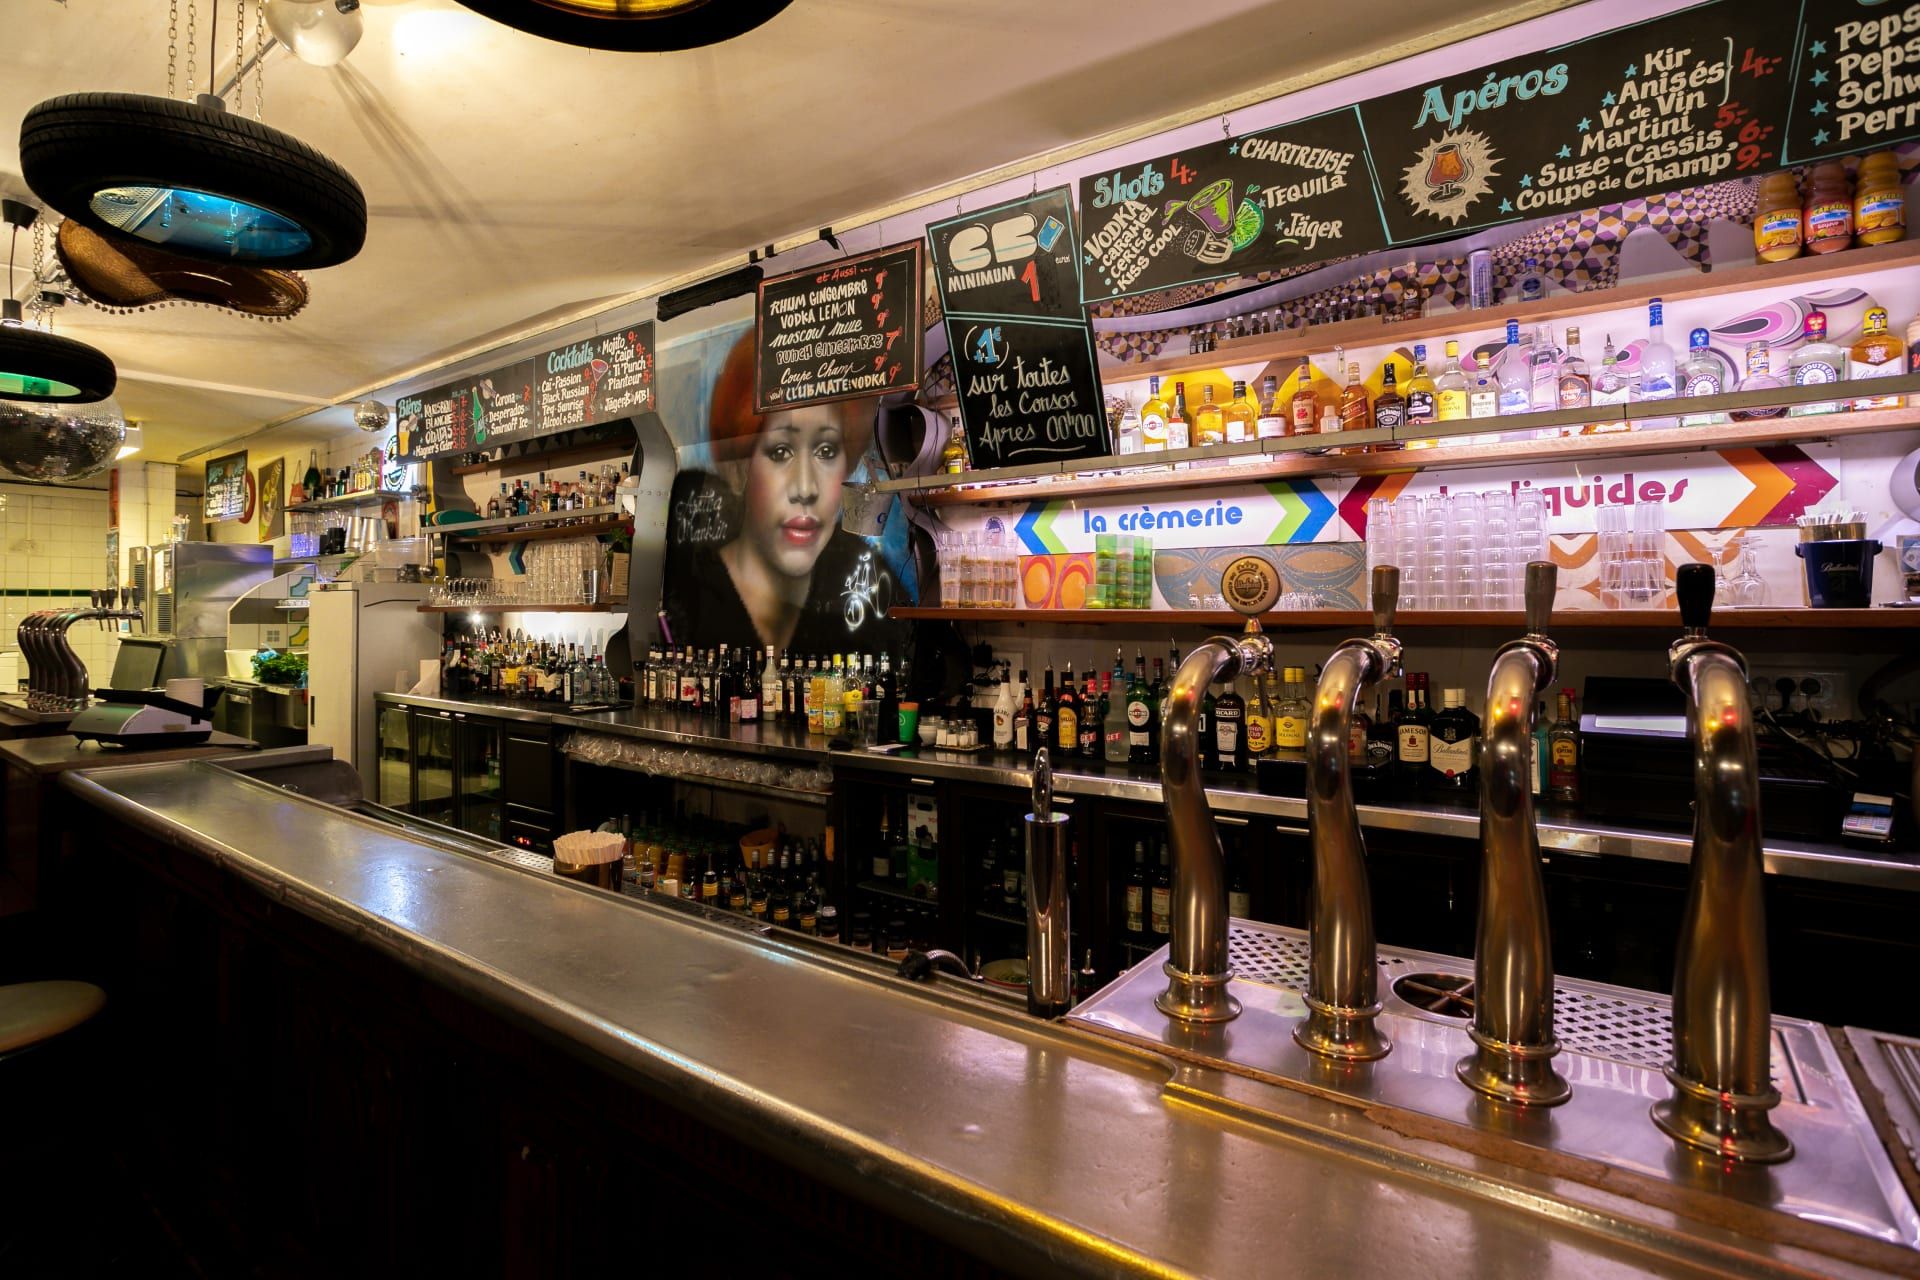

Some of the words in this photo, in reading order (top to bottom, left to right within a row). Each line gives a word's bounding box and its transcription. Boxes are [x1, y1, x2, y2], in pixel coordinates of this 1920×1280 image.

[1642, 47, 1693, 77] Kir
[1618, 54, 1726, 105] Anisés
[1412, 62, 1570, 131] Apéros
[1599, 107, 1625, 129] V.
[1628, 104, 1651, 120] de
[1657, 88, 1708, 117] Vin
[1579, 112, 1695, 158] Martini
[1241, 137, 1354, 175] CHARTREUSE
[1537, 129, 1724, 188] Suze-Cassis
[1093, 164, 1164, 208] Shots
[1515, 180, 1598, 211] Coupe
[1598, 176, 1621, 192] de
[1083, 199, 1147, 259] VODKA
[948, 213, 1038, 273] CB
[816, 272, 829, 284] et
[831, 265, 857, 281] Aussi
[947, 265, 1016, 293] MINIMUM
[1021, 260, 1041, 303] 1
[769, 294, 806, 317] RHUM
[780, 311, 816, 330] VODKA
[818, 299, 855, 322] LEMON
[547, 340, 594, 374] Cocktails
[602, 333, 626, 356] Mojito
[614, 344, 634, 363] Caïpi
[541, 373, 582, 394] Caï-Passion
[608, 373, 643, 391] Planteur
[780, 366, 813, 391] Coupe
[966, 374, 1008, 398] sur
[1013, 355, 1070, 389] toutes
[1687, 375, 1714, 394] PLYMOUTH
[1797, 363, 1827, 385] PLYMOUTH
[398, 399, 422, 418] Bières
[495, 392, 516, 408] Corona
[542, 390, 564, 406] Black
[563, 385, 590, 400] Russian
[542, 399, 585, 417] Teq-Sunrise
[989, 395, 1013, 419] les
[1018, 390, 1078, 418] Consos
[489, 402, 525, 422] Desperados
[491, 417, 518, 436] Smirnoff
[518, 416, 529, 429] Ice
[1083, 510, 1107, 534] la
[1118, 499, 1243, 531] crèmerie
[1106, 732, 1121, 742] GET
[1399, 726, 1427, 735] JAMESON
